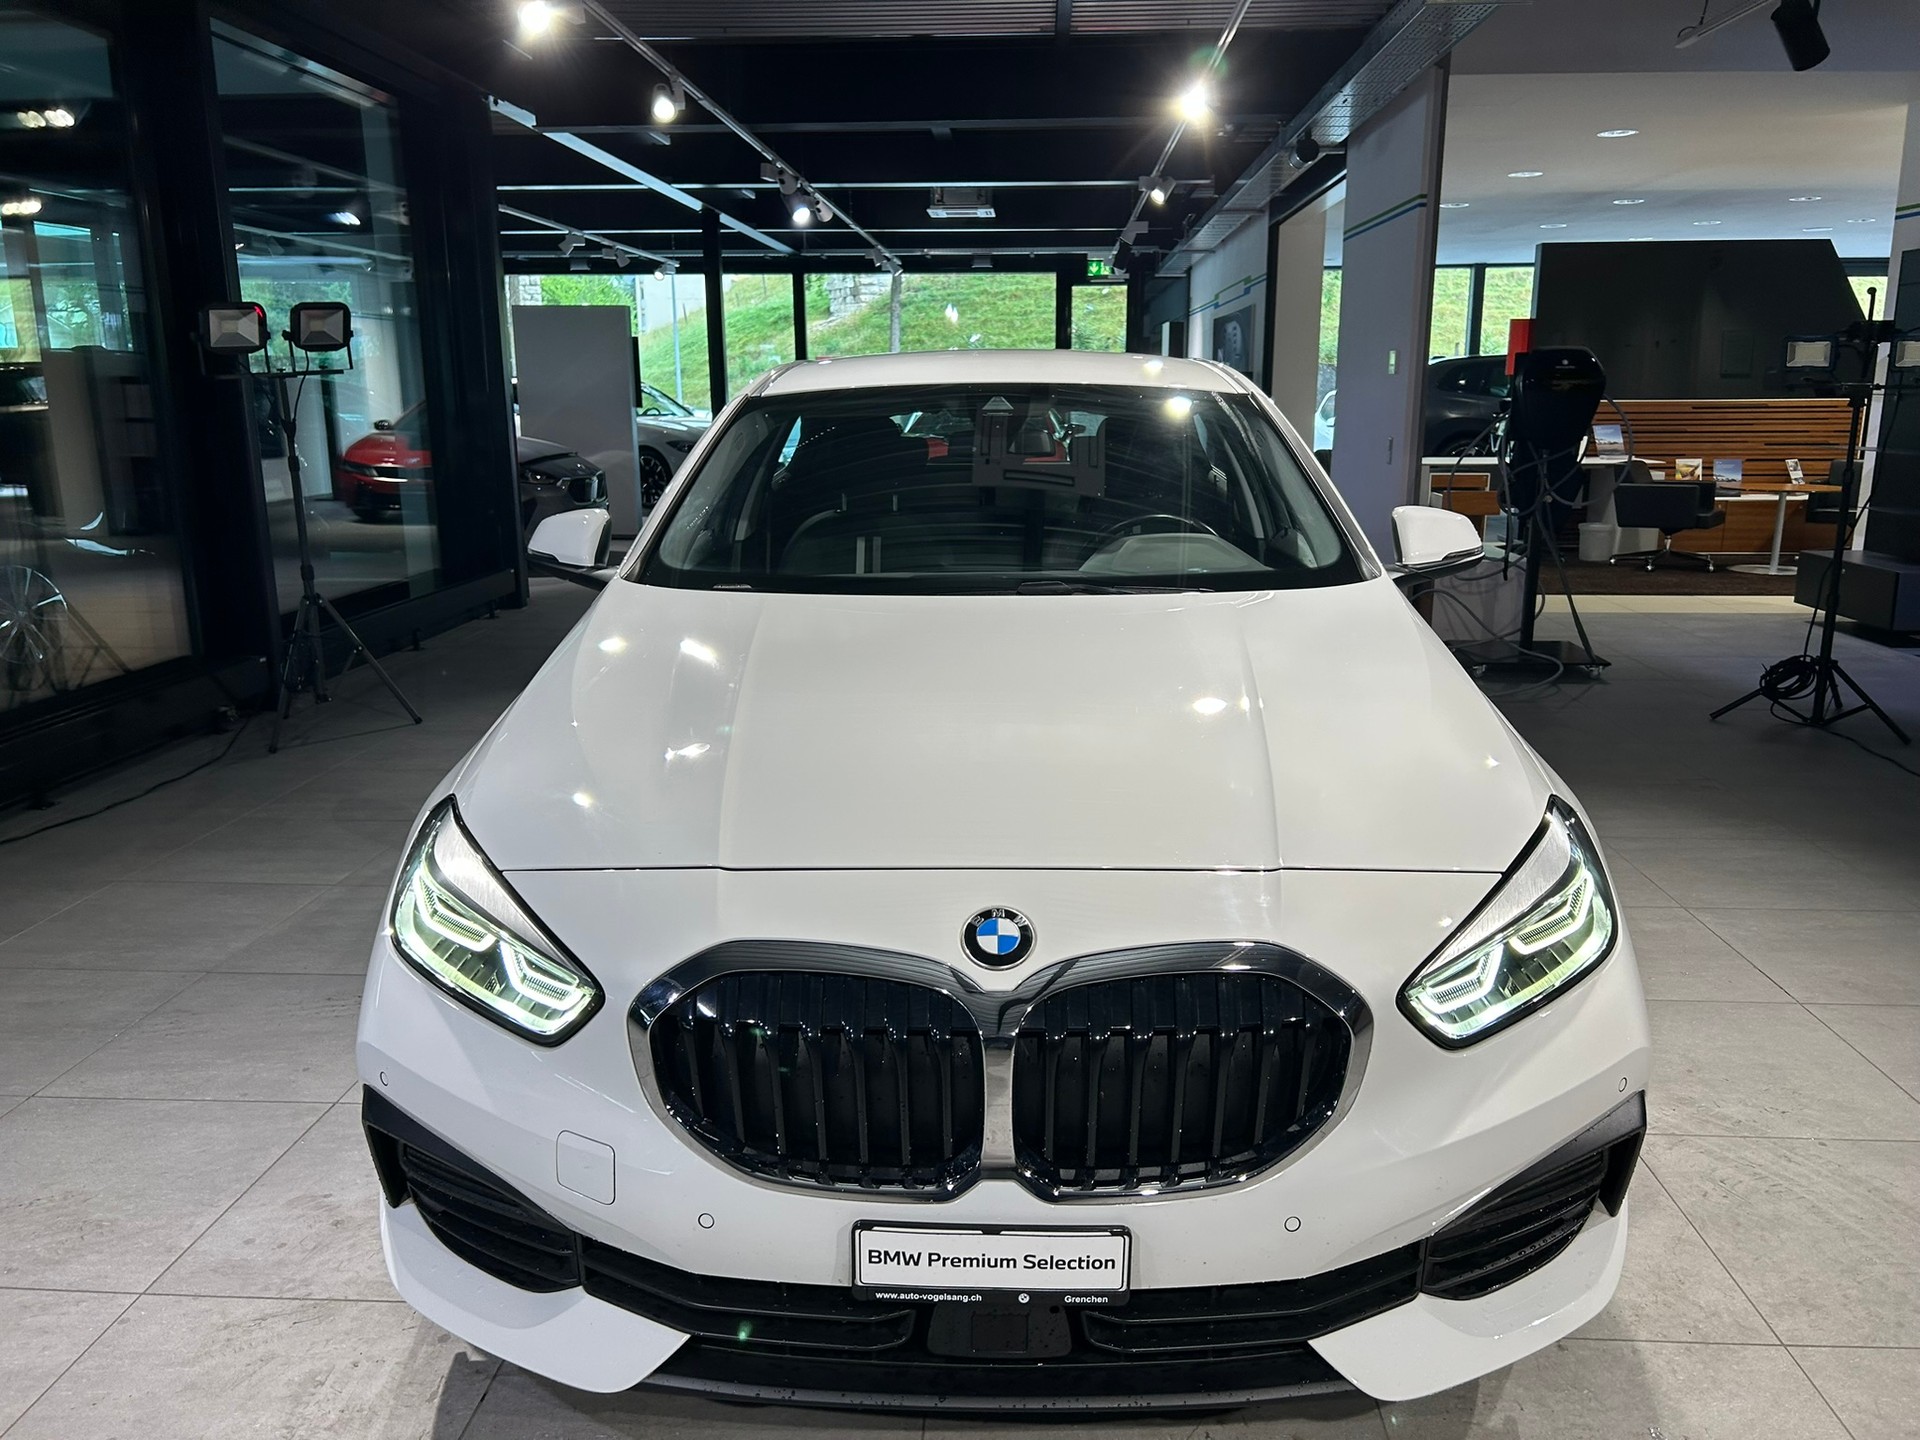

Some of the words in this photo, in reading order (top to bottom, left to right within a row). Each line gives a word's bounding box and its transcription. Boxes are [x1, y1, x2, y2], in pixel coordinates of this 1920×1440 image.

[868, 1249, 922, 1267] BMW
[928, 1252, 1017, 1269] Premium
[1023, 1254, 1116, 1270] Selection
[875, 1291, 982, 1303] www.auto-vogelsang.ch
[1064, 1295, 1109, 1304] Grenchen
